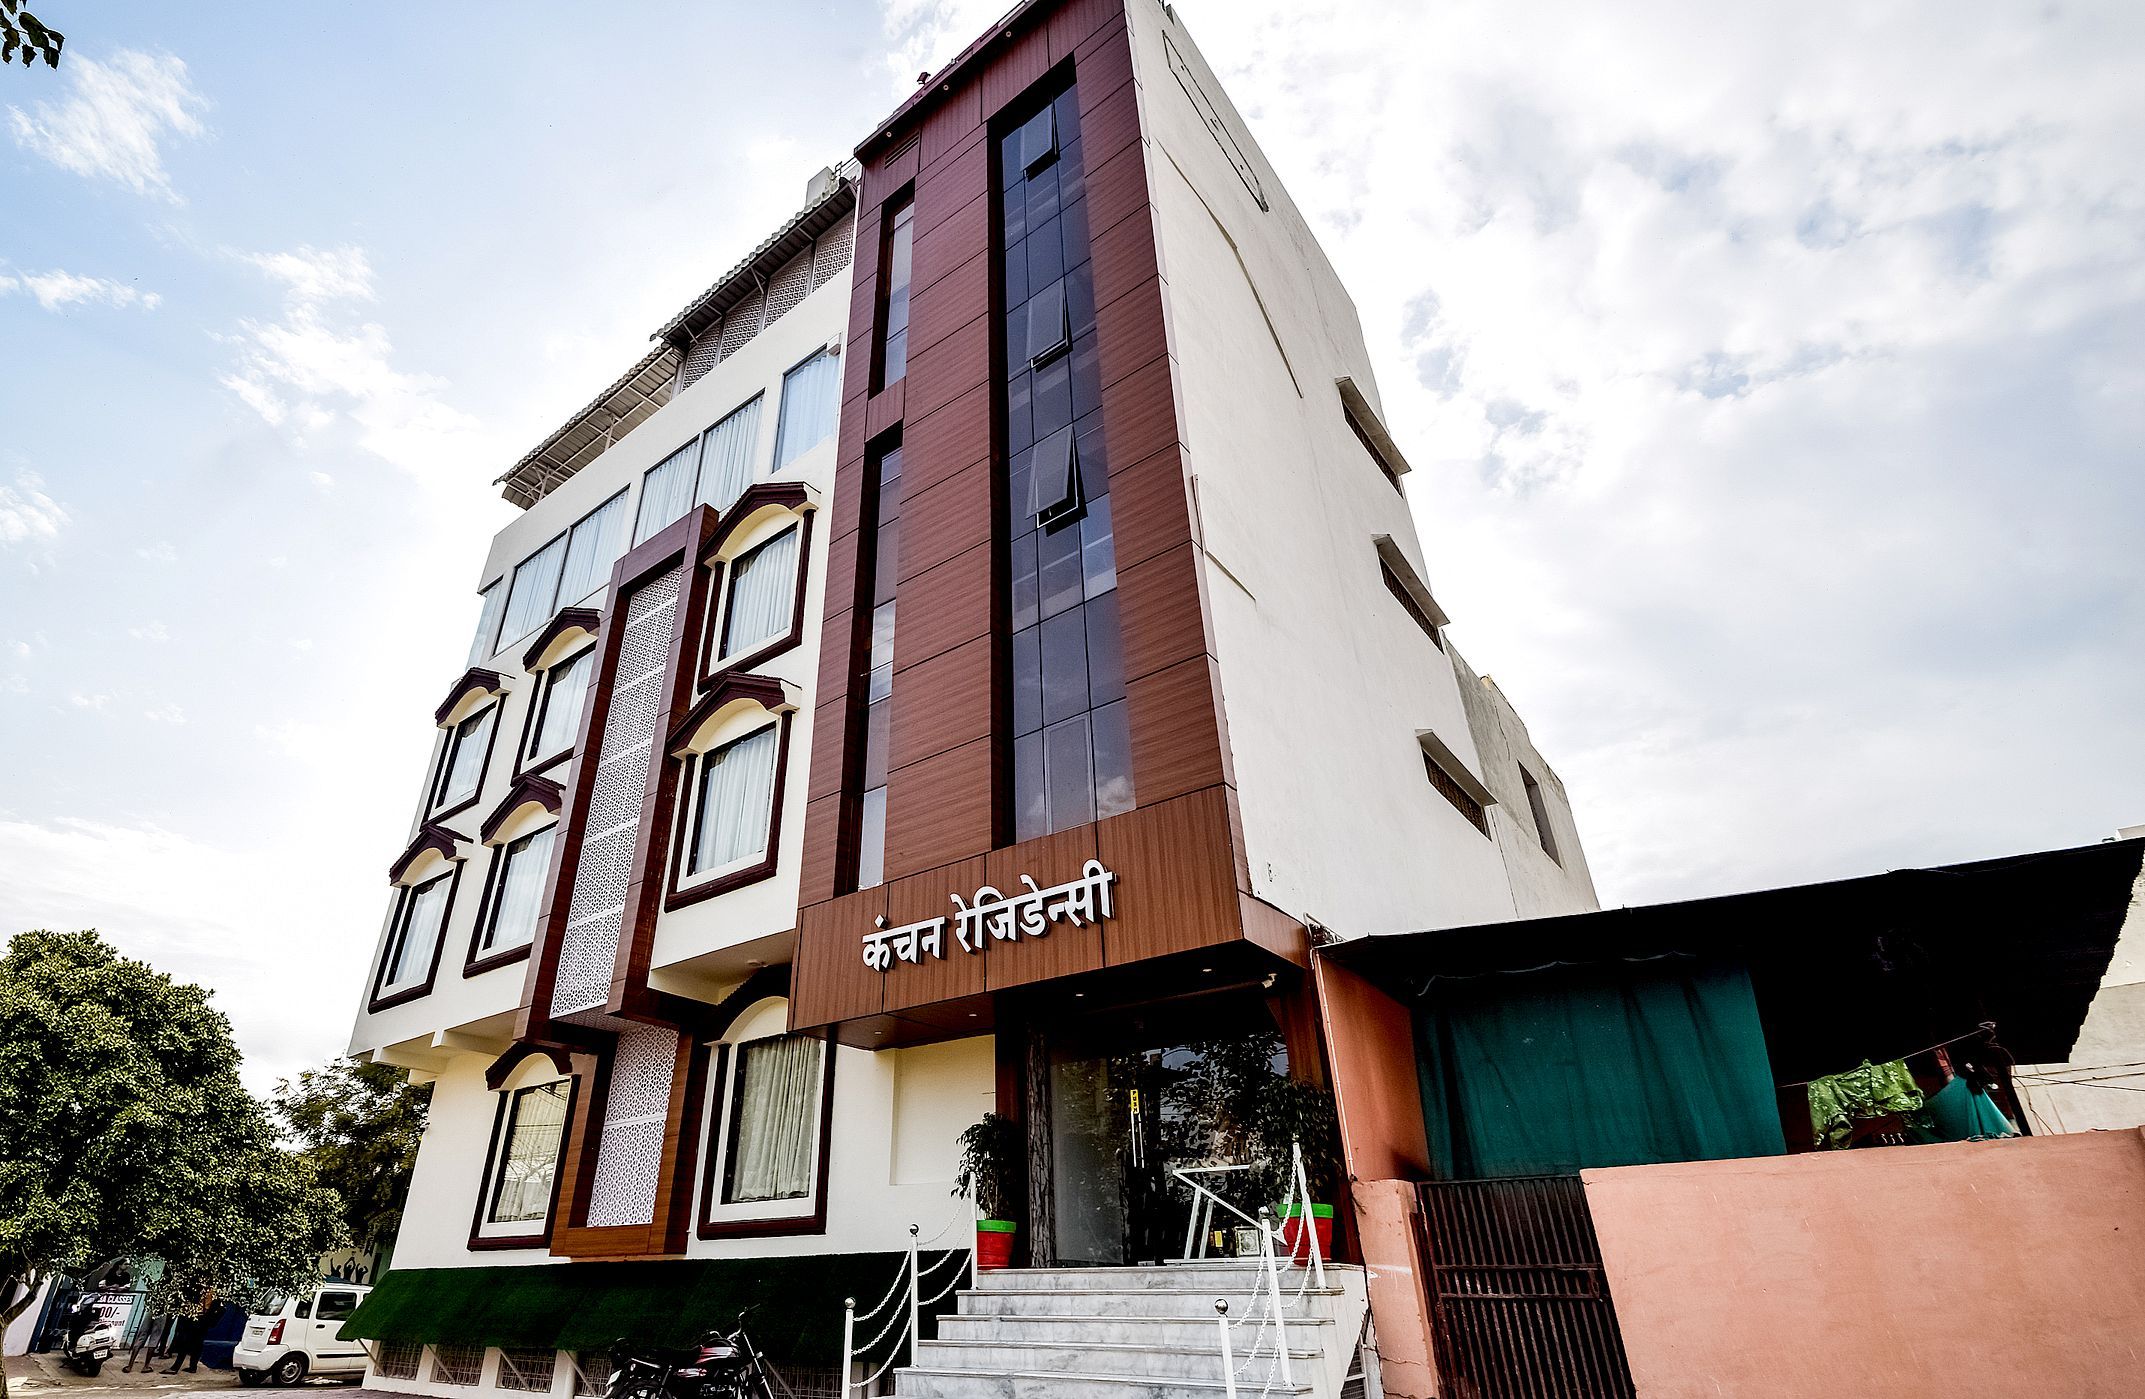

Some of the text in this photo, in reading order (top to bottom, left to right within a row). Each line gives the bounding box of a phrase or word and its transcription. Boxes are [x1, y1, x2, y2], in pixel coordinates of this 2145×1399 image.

[862, 859, 1114, 972] कंचन रेजिडेन्सी
[107, 1295, 133, 1304] CLASSES
